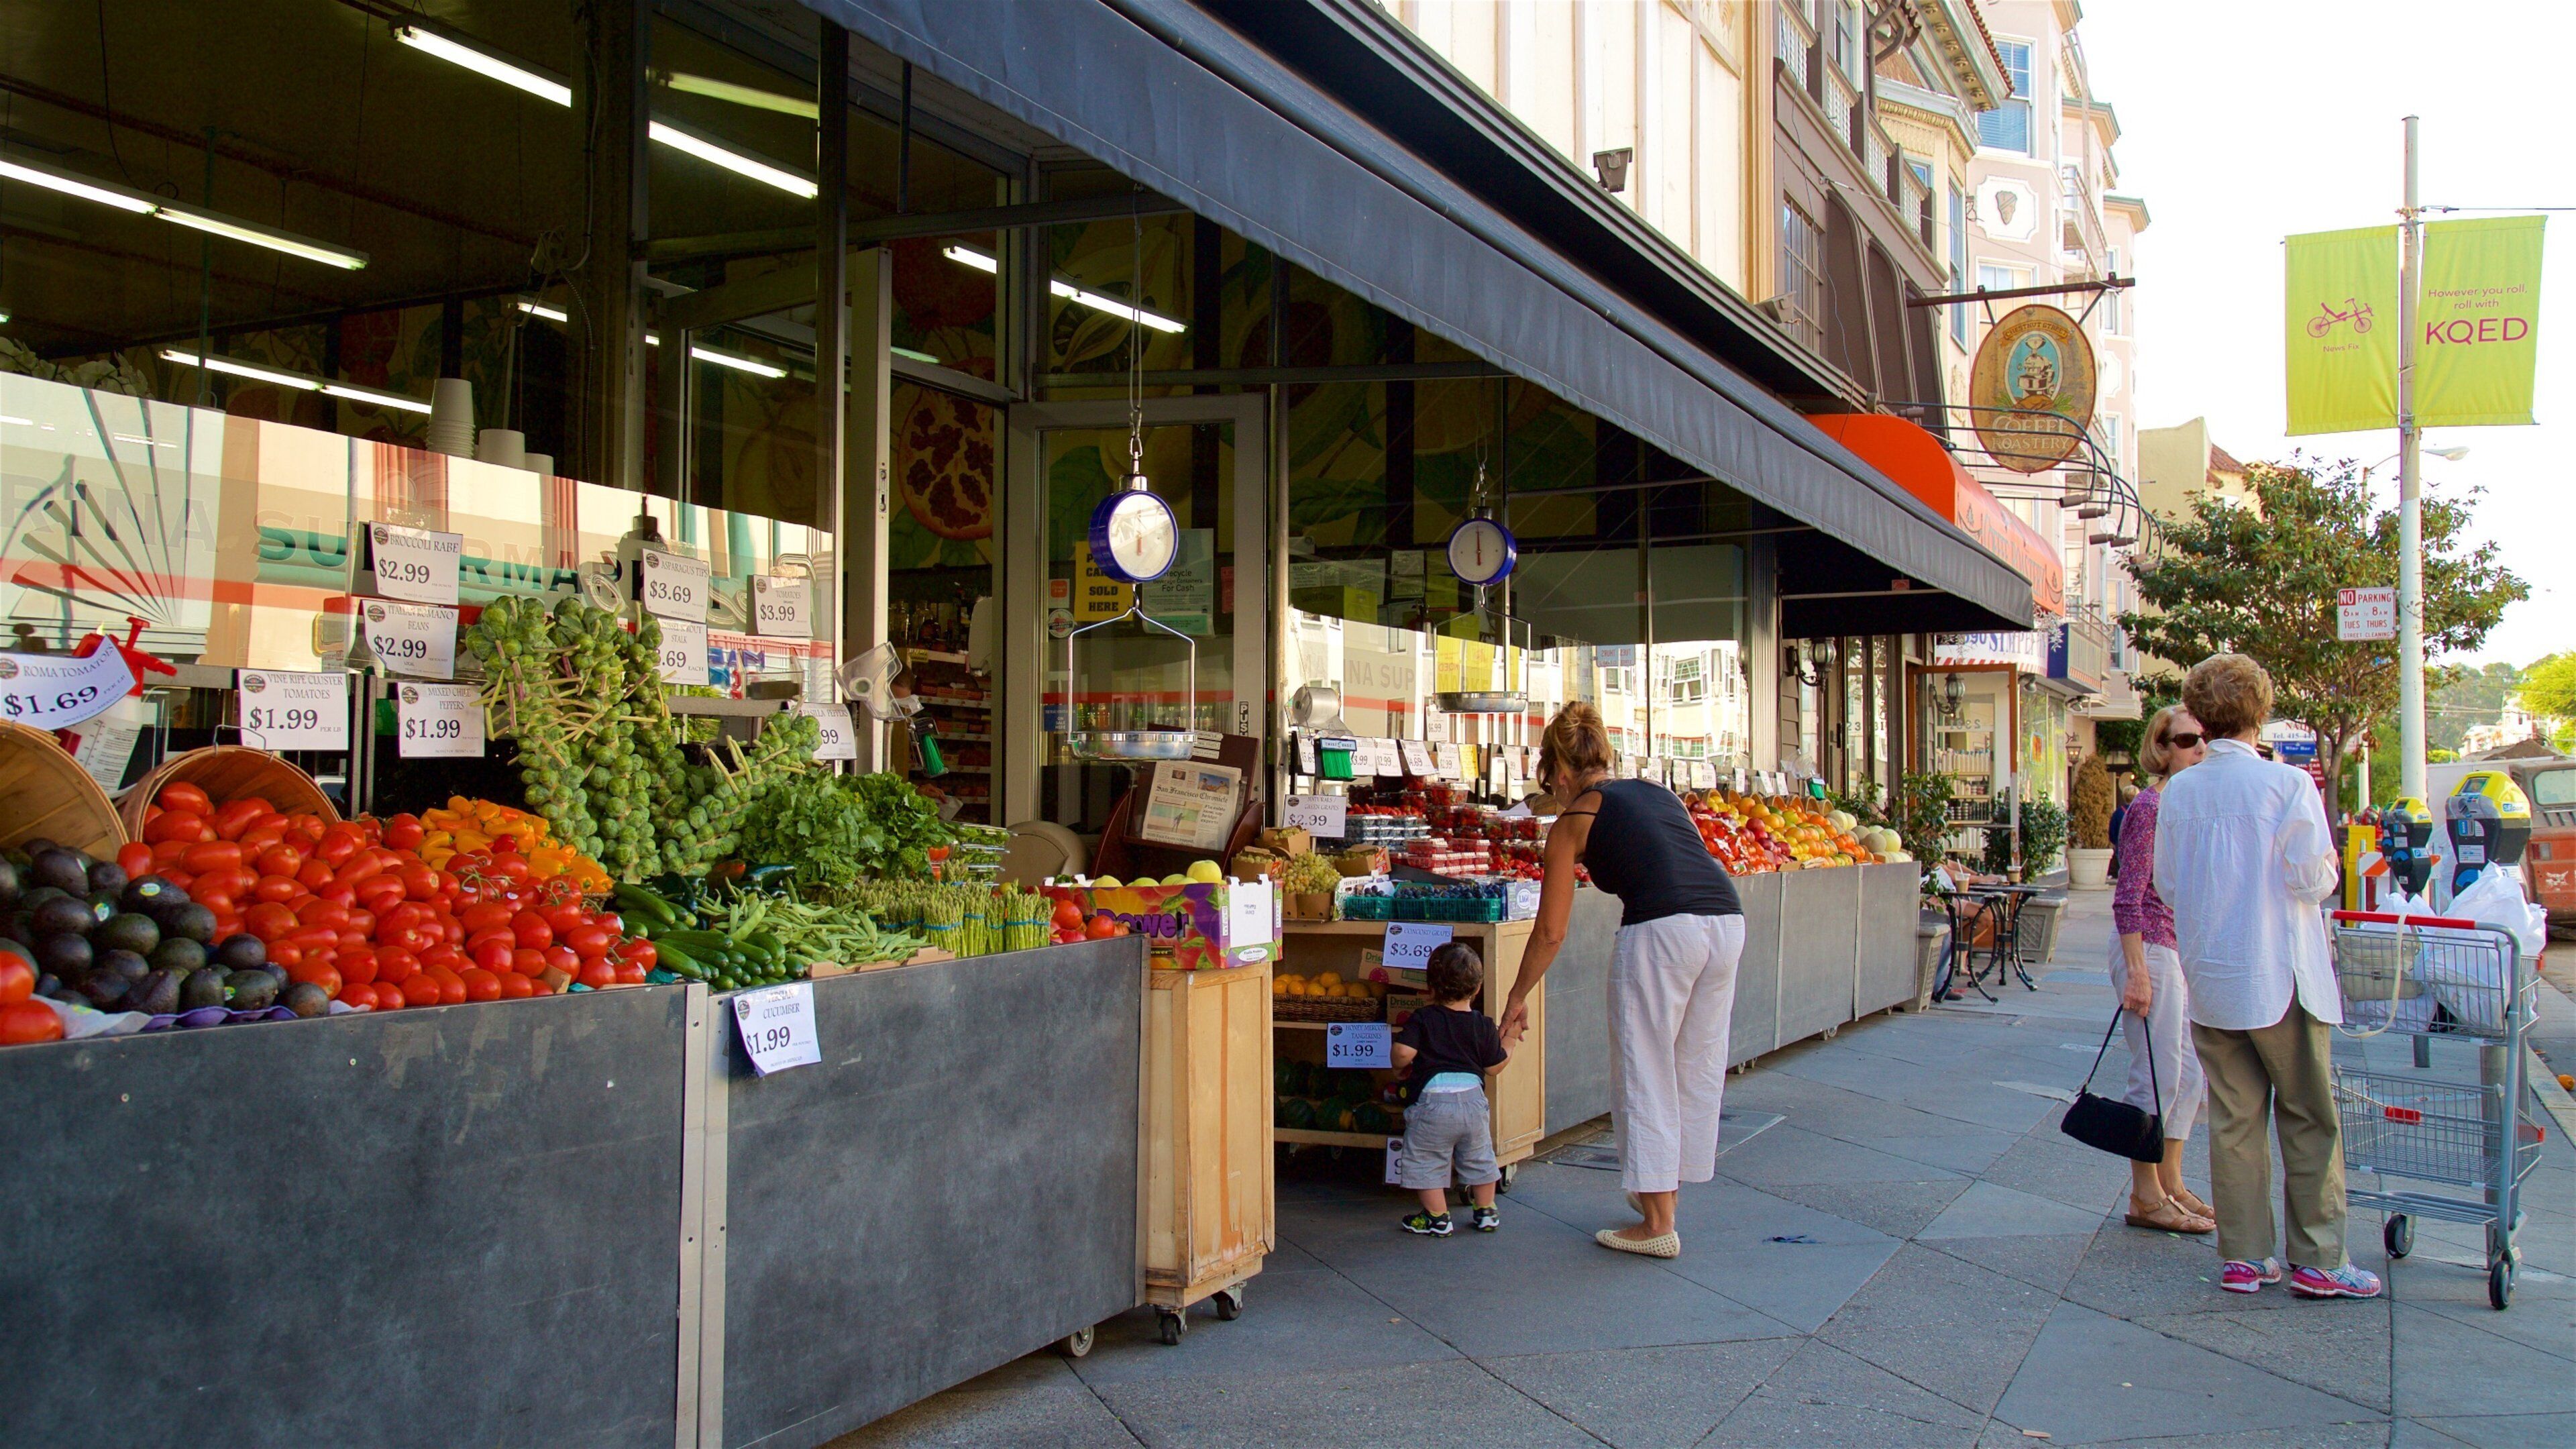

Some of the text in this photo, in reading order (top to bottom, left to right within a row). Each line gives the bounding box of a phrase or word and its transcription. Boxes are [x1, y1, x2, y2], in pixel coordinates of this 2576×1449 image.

[2428, 284, 2528, 298] However you roll,
[2454, 299, 2499, 309] roll with
[2005, 321, 2068, 337] CHESTNUT STREET
[2426, 317, 2528, 345] KQED
[1992, 438, 2070, 449] ROASTERY
[390, 534, 459, 553] BROCCOLI RABE
[379, 557, 430, 584] $2.99
[661, 560, 708, 578] ASPARAGUS TIPS
[649, 579, 691, 604] $3.69
[1089, 586, 1119, 596] SOLD
[1176, 584, 1195, 592] Cash
[2339, 590, 2392, 605] NO PARKING
[759, 602, 796, 622] $3.99
[1088, 601, 1119, 612] HERE
[417, 608, 454, 620] ROMANO
[408, 620, 429, 631] BEANS
[2344, 619, 2387, 629] TUES THURS
[671, 635, 688, 644] STALK
[374, 635, 427, 659] $2.99
[23, 643, 115, 678] ROMA TOMATOES
[268, 674, 343, 686] VINE RIPE CLUSTER
[283, 688, 331, 700] TOMATOES
[428, 687, 451, 697] MIXED
[4, 685, 99, 717] $1.69
[439, 700, 465, 710] PEPPERS
[250, 706, 319, 731] $1.99
[405, 717, 461, 741] $1.99
[1155, 784, 1229, 803] San Francisco Chronicle
[1307, 796, 1333, 804] NATURALS
[1288, 813, 1328, 827] $2.99
[1403, 926, 1452, 938] CONCORD GRAPES
[1390, 942, 1433, 958] $3.69
[763, 1002, 800, 1020] CUCUMBER
[746, 1026, 791, 1057] $1.99
[1332, 1044, 1374, 1058] $1.99
